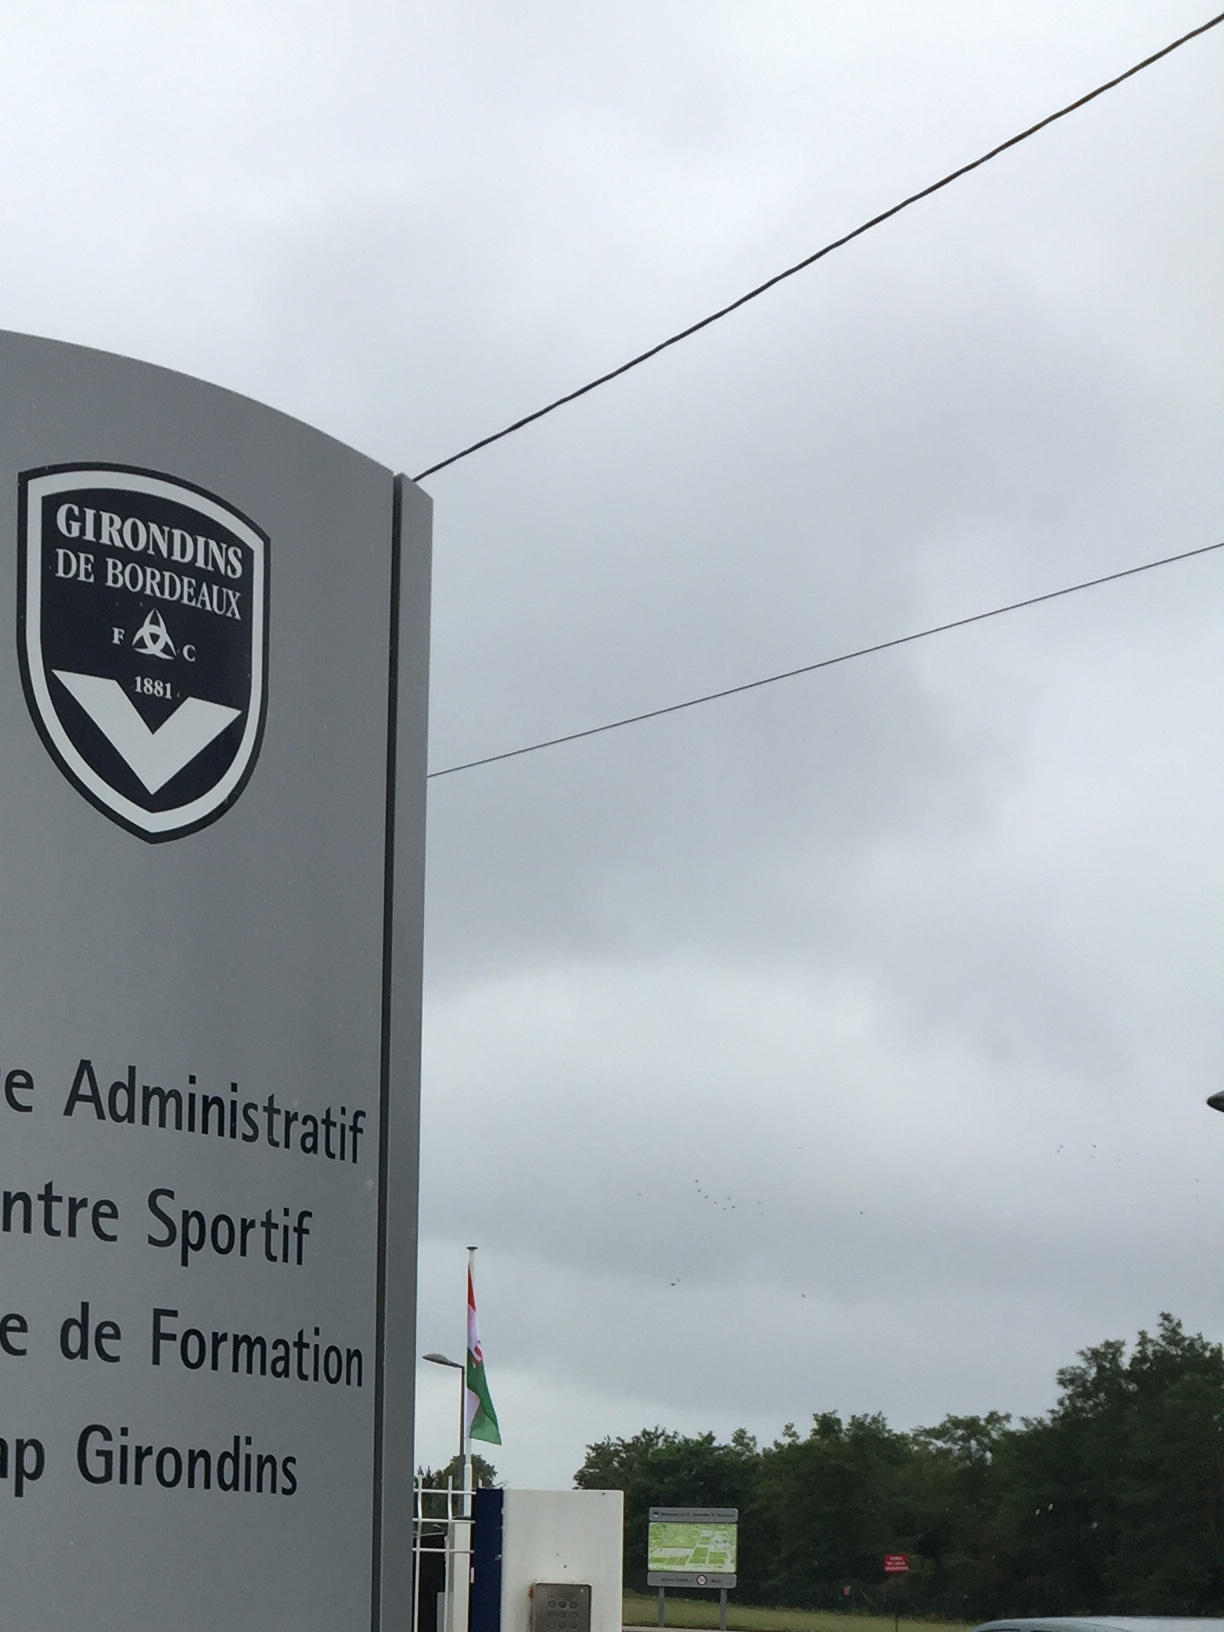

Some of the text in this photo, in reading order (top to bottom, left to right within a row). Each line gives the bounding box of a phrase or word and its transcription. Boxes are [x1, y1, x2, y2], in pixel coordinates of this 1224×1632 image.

[56, 503, 243, 579] GIRONDINS
[55, 548, 242, 621] DE BORDEAUX
[112, 627, 196, 662] F C
[134, 675, 173, 700] 1881
[63, 1058, 367, 1165] Administratif
[147, 1187, 313, 1268] Sportif
[59, 1301, 122, 1363] de
[151, 1307, 363, 1388] Formation
[77, 1423, 298, 1496] Girondins
